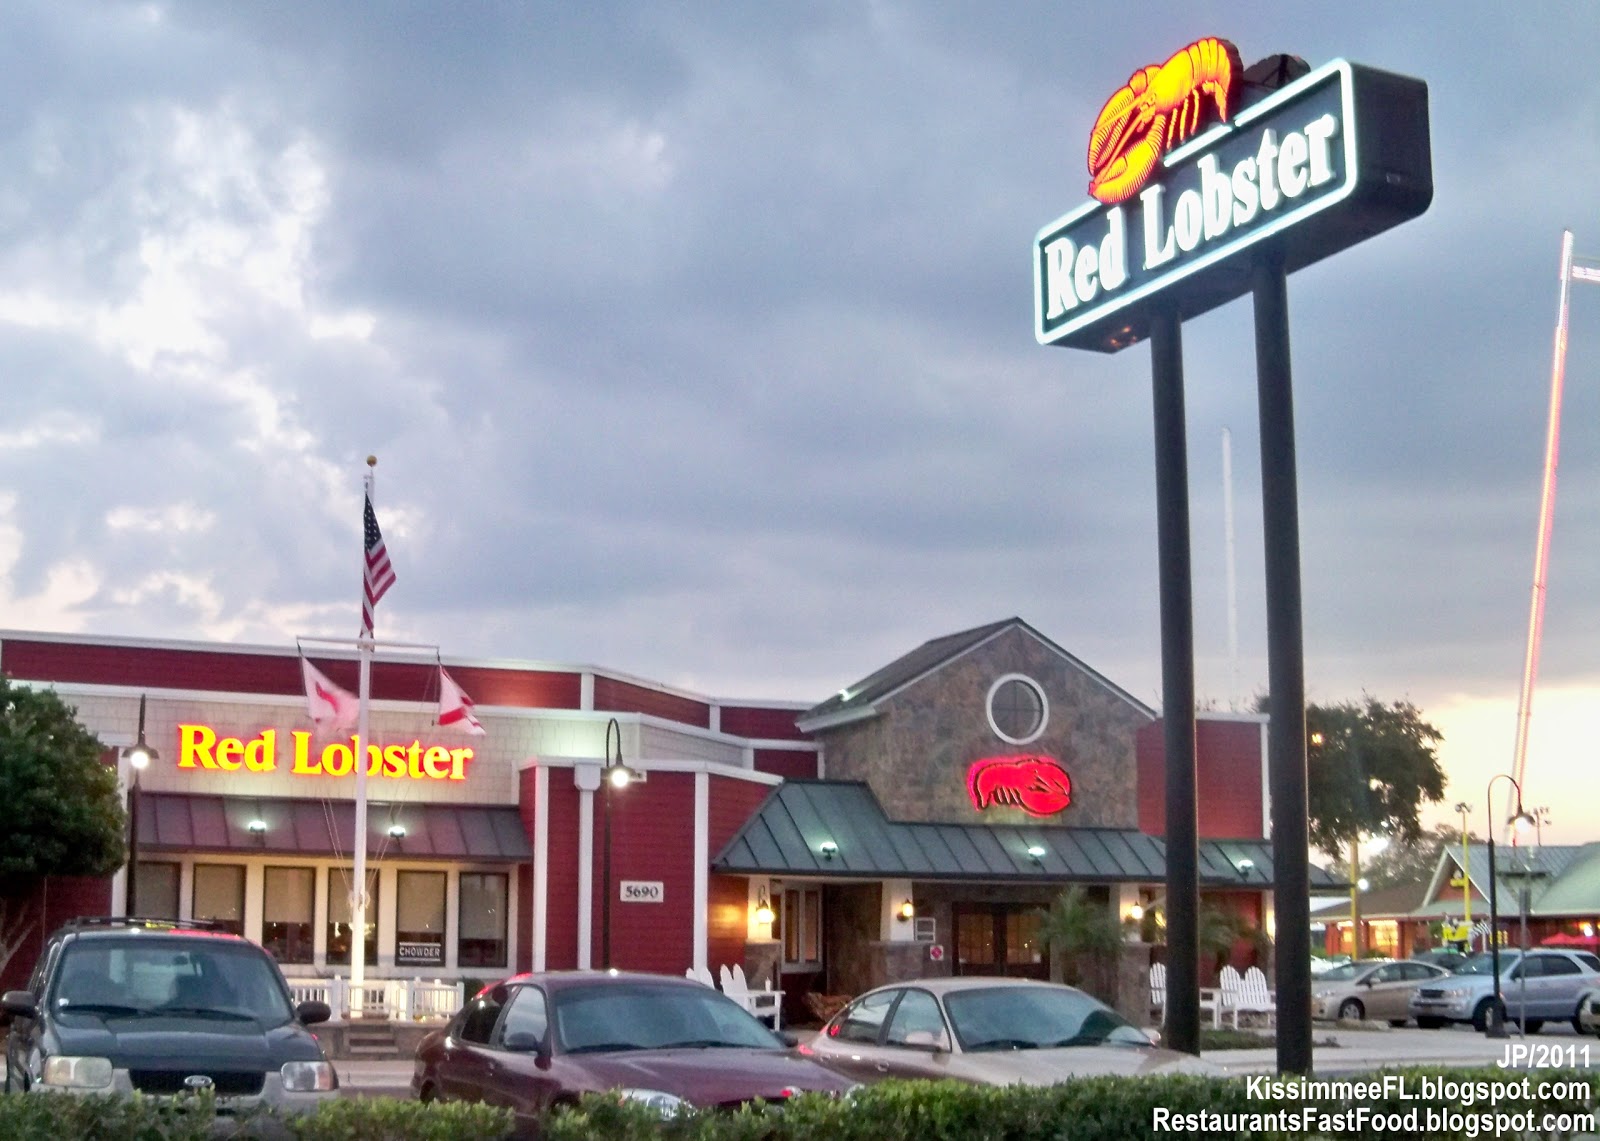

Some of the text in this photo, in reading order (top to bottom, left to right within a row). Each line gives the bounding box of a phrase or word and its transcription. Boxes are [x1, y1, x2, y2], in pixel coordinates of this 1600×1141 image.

[1045, 113, 1338, 319] Red Lobster
[178, 724, 474, 780] Red Lobster
[625, 885, 659, 898] 5690
[399, 946, 440, 957] CHOWDER
